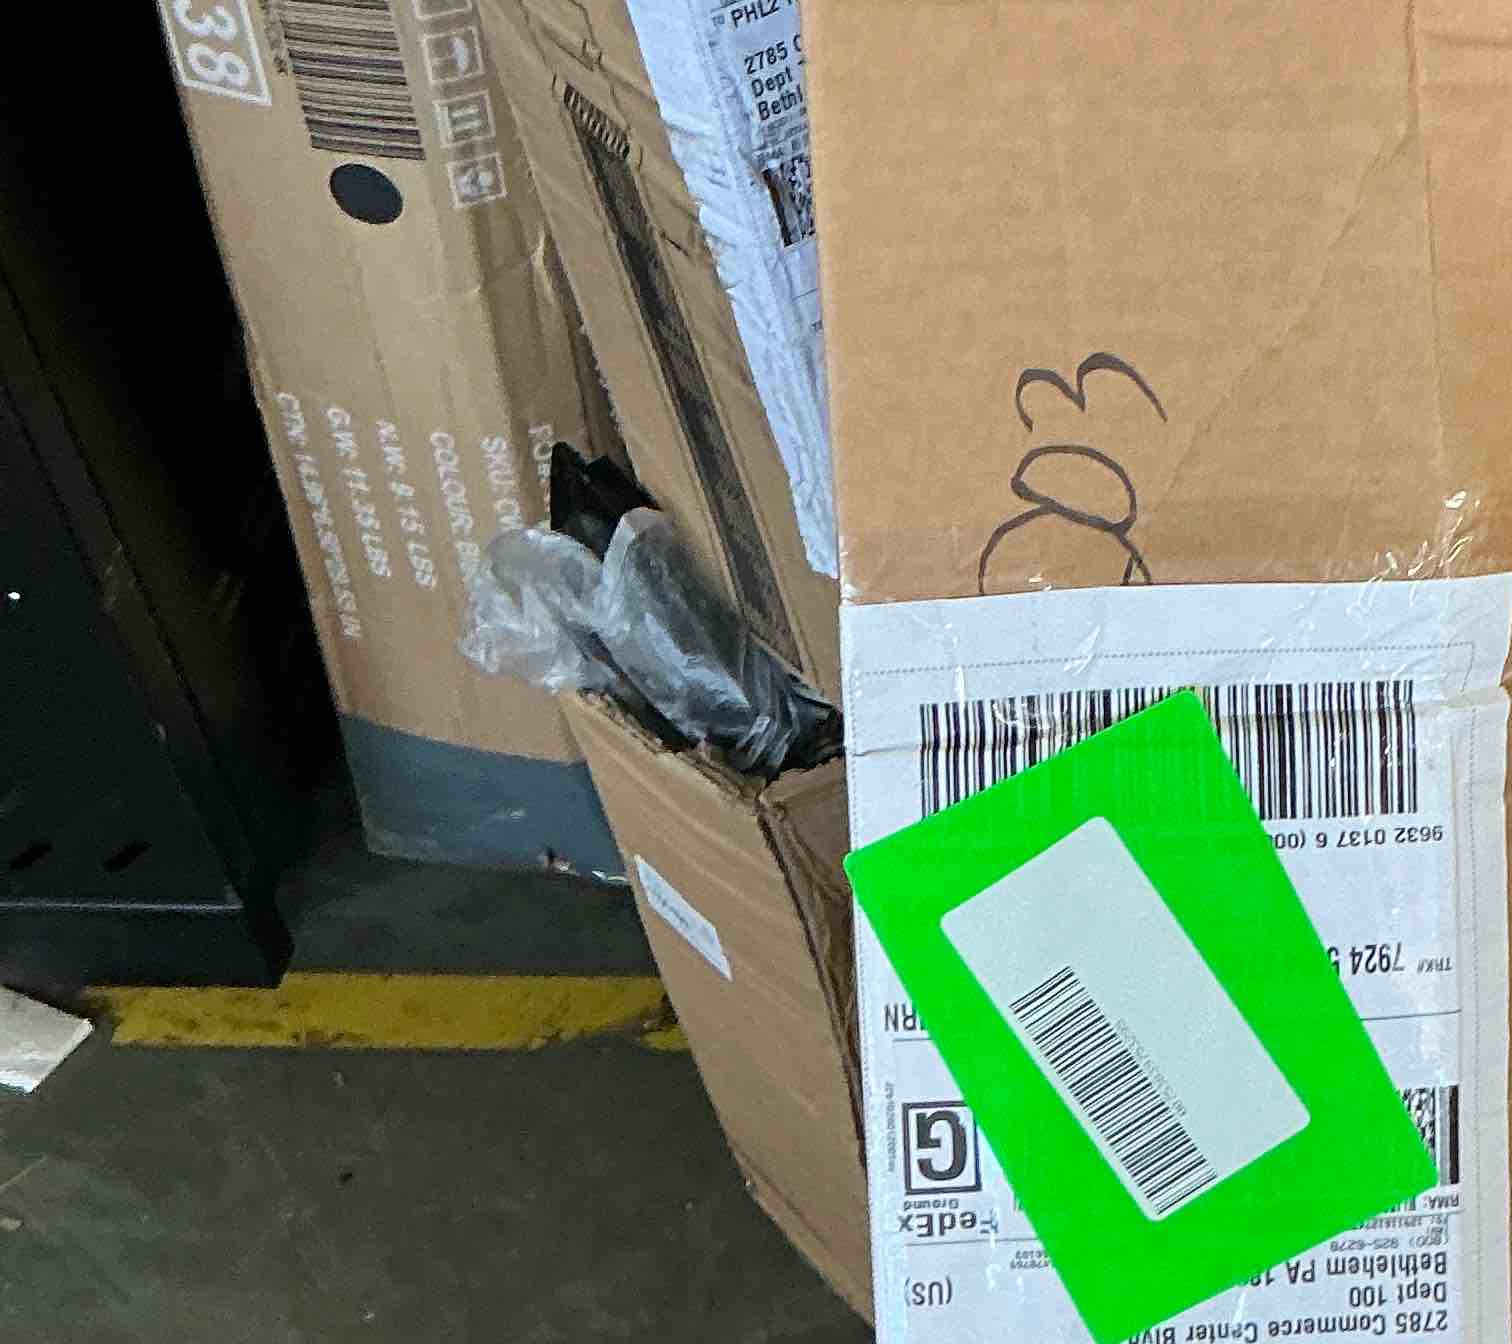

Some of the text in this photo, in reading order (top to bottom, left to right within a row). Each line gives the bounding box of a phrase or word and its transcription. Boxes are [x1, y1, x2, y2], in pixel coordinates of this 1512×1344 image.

[743, 41, 789, 76] 2785
[750, 72, 794, 100] Dept
[1315, 832, 1327, 847] 6
[1336, 828, 1385, 846] 0137
[1394, 825, 1442, 842] 9632
[1349, 942, 1404, 974] 7924
[916, 1108, 969, 1183] G
[903, 1197, 959, 1212] Ground
[896, 1207, 999, 1241] FedEx
[1285, 1259, 1316, 1283] PA
[1325, 1247, 1447, 1283] Bethlehem
[902, 1273, 953, 1307] (US)
[1347, 1276, 1447, 1308] Dept 100
[1266, 1311, 1386, 1344] Commerce
[1394, 1308, 1449, 1335] 2785
